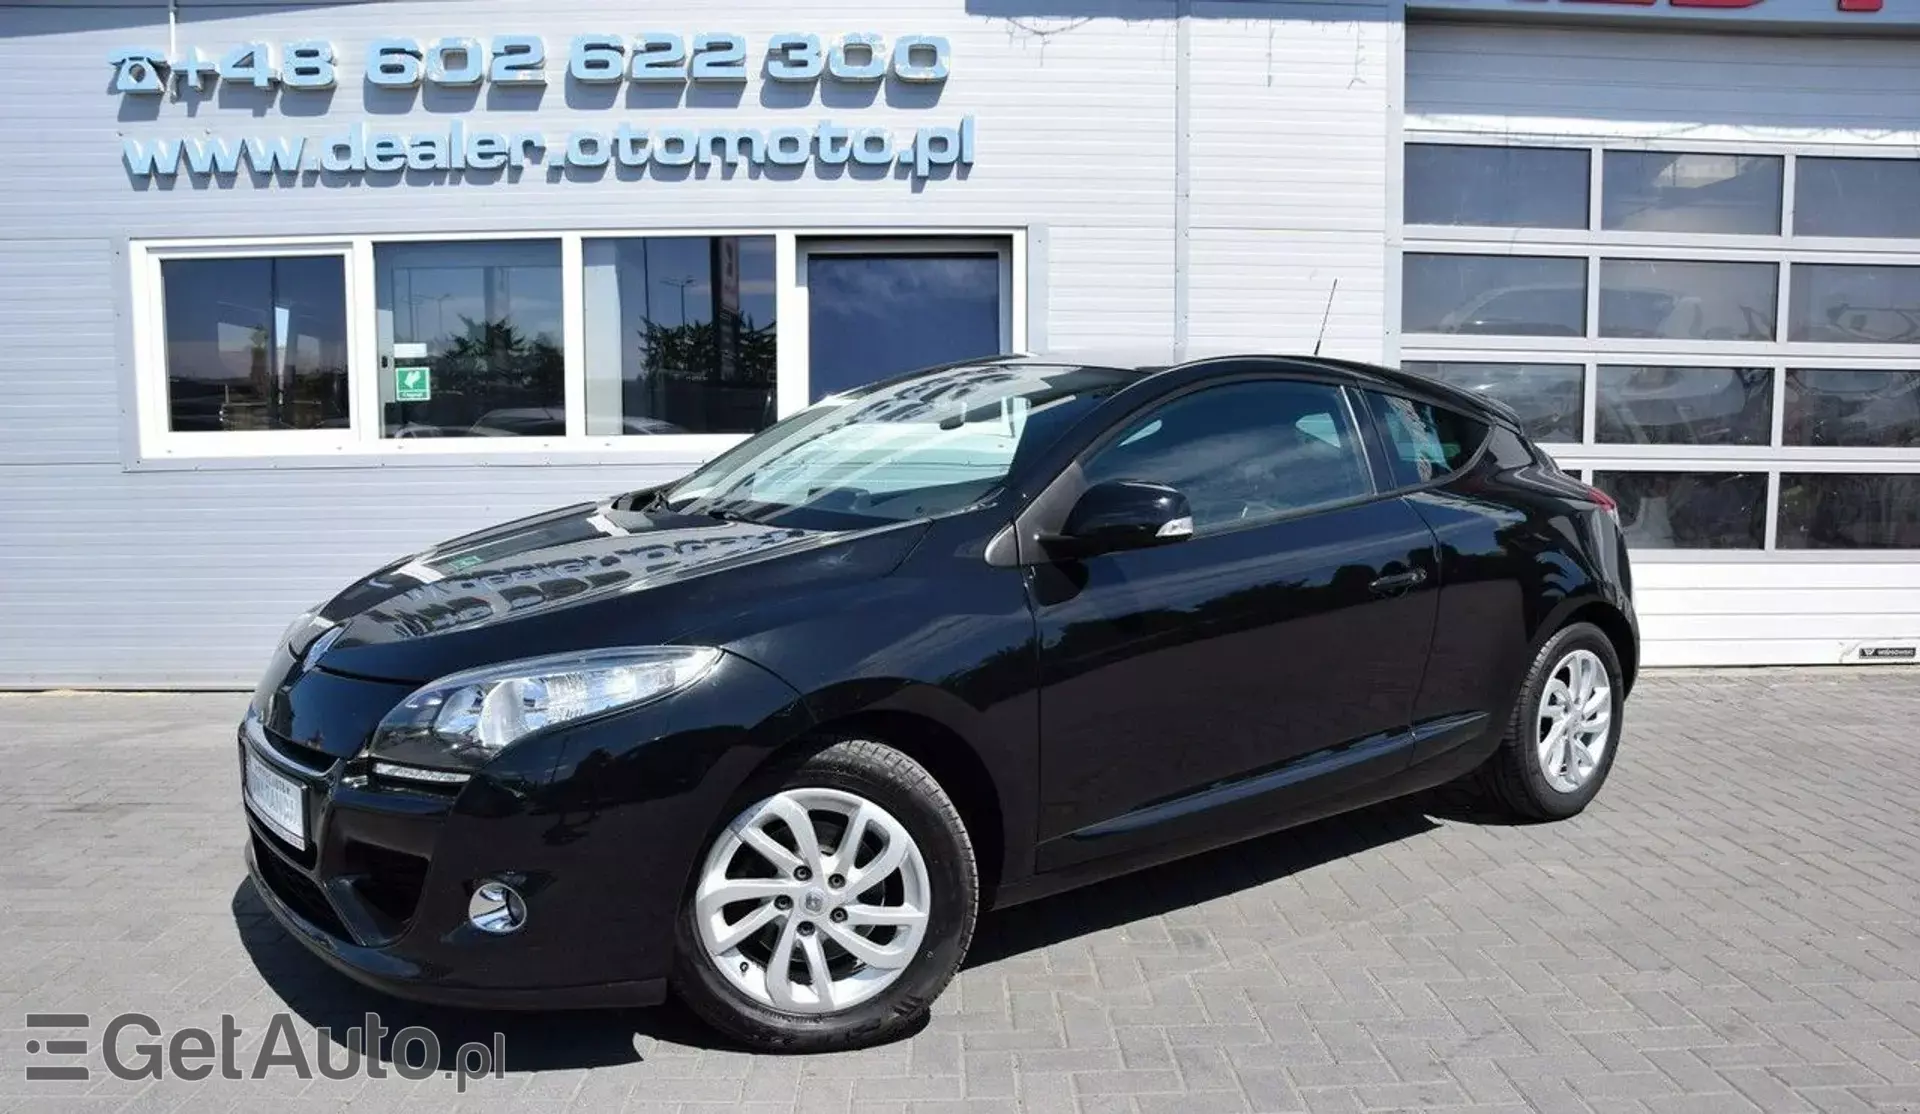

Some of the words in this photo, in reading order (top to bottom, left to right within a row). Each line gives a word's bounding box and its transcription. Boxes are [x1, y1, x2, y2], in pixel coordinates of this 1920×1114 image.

[171, 39, 337, 89] +48
[364, 36, 546, 88] 602
[567, 32, 747, 83] 622
[765, 32, 951, 83] 300
[122, 113, 975, 177] www.dealer.otomoto.pl
